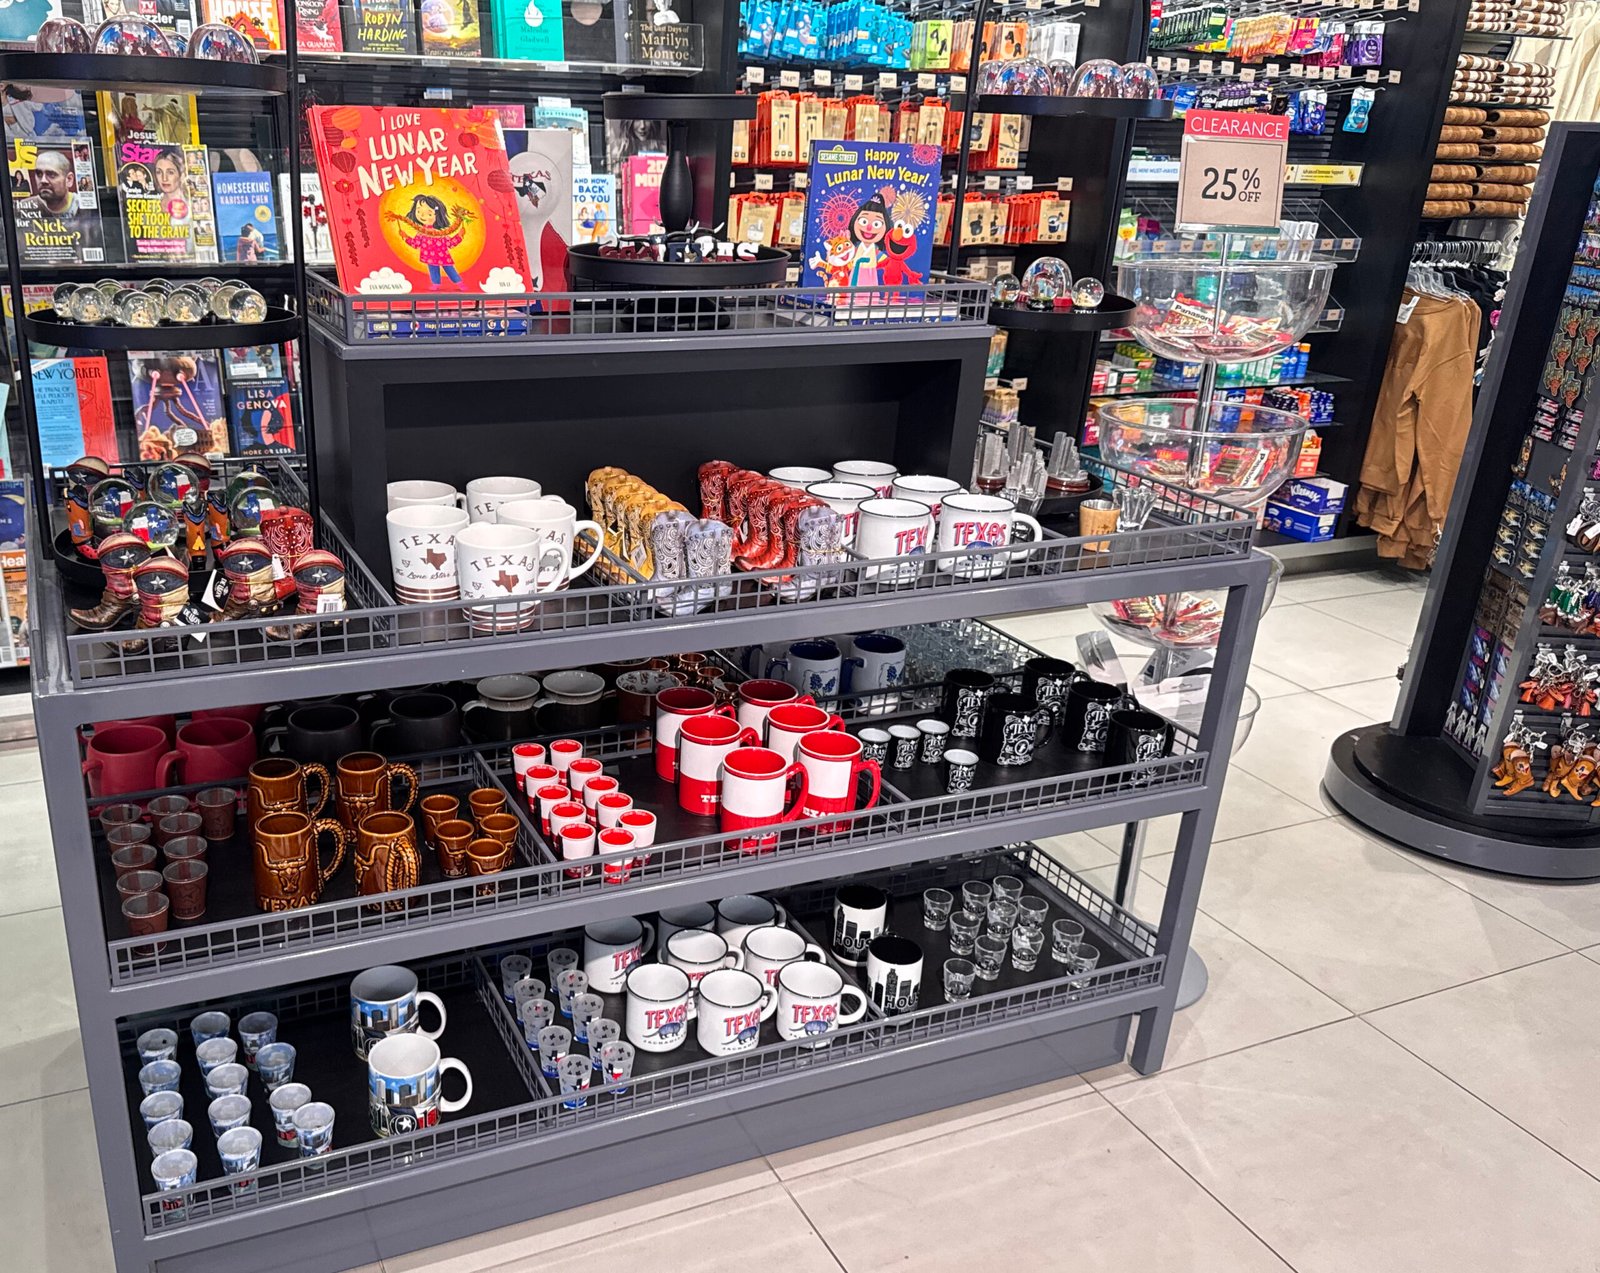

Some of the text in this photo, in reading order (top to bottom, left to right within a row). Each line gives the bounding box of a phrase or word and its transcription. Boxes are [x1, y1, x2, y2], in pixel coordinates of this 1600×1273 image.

[365, 11, 403, 27] ROBYN
[357, 28, 407, 42] HARDING
[640, 24, 651, 32] The
[668, 25, 682, 34] Days
[641, 33, 689, 47] Marilyn
[642, 47, 689, 60] Monroe
[380, 113, 421, 131] I LOVE
[1190, 116, 1284, 138] CLEARANCE
[127, 130, 158, 140] Jesus
[368, 128, 448, 161] LUNAR
[121, 143, 164, 163] Star
[820, 152, 838, 161] SESAME
[864, 148, 900, 165] Happy
[357, 152, 479, 200] NEW YEAR
[591, 178, 610, 186] NOW,
[825, 164, 930, 188] Lunar New Year!
[216, 181, 270, 194] HOMESEEKING
[578, 185, 605, 193] BACK
[573, 195, 611, 203] TO YOU
[1238, 191, 1262, 202] OFF
[126, 198, 162, 213] SECRETS
[20, 210, 43, 219] Next
[128, 212, 171, 226] SHE TOOK
[16, 219, 68, 233] for Nick
[130, 225, 190, 239] TO THE GRAVE
[25, 231, 82, 246] Reiner?
[32, 366, 102, 380] NEW YORKER
[247, 389, 274, 399] LISA
[236, 399, 287, 410] GENOVA
[953, 522, 1007, 547] TEXAS
[399, 533, 456, 551] TEXA
[470, 554, 536, 573] TEXAS
[260, 894, 318, 913] TEXAS
[792, 1002, 838, 1024] TEXAS
[724, 1008, 761, 1037] TEXA
